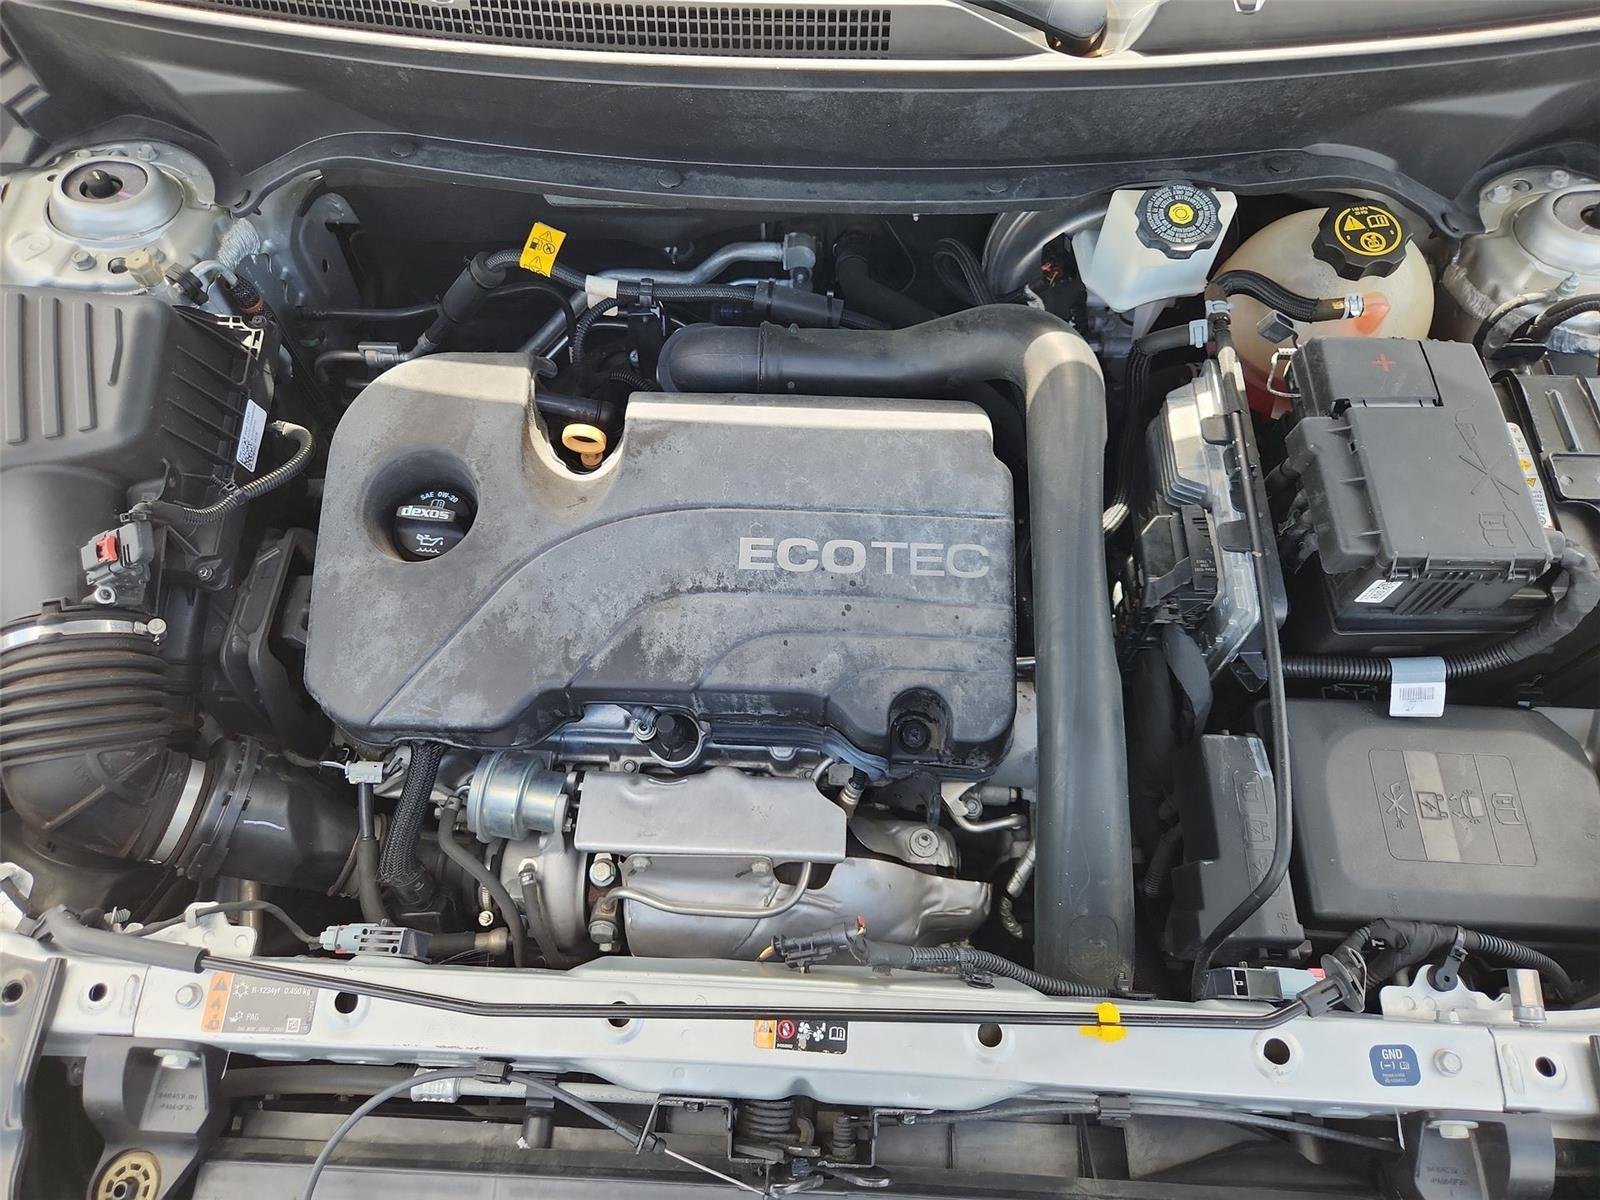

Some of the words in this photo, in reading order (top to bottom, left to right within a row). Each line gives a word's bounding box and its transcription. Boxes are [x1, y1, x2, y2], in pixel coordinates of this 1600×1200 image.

[420, 491, 434, 501] SAE
[437, 491, 459, 503] 0W-20
[400, 505, 450, 520] dexos
[738, 537, 990, 578] ECOTEC
[1382, 1048, 1403, 1060] GND
